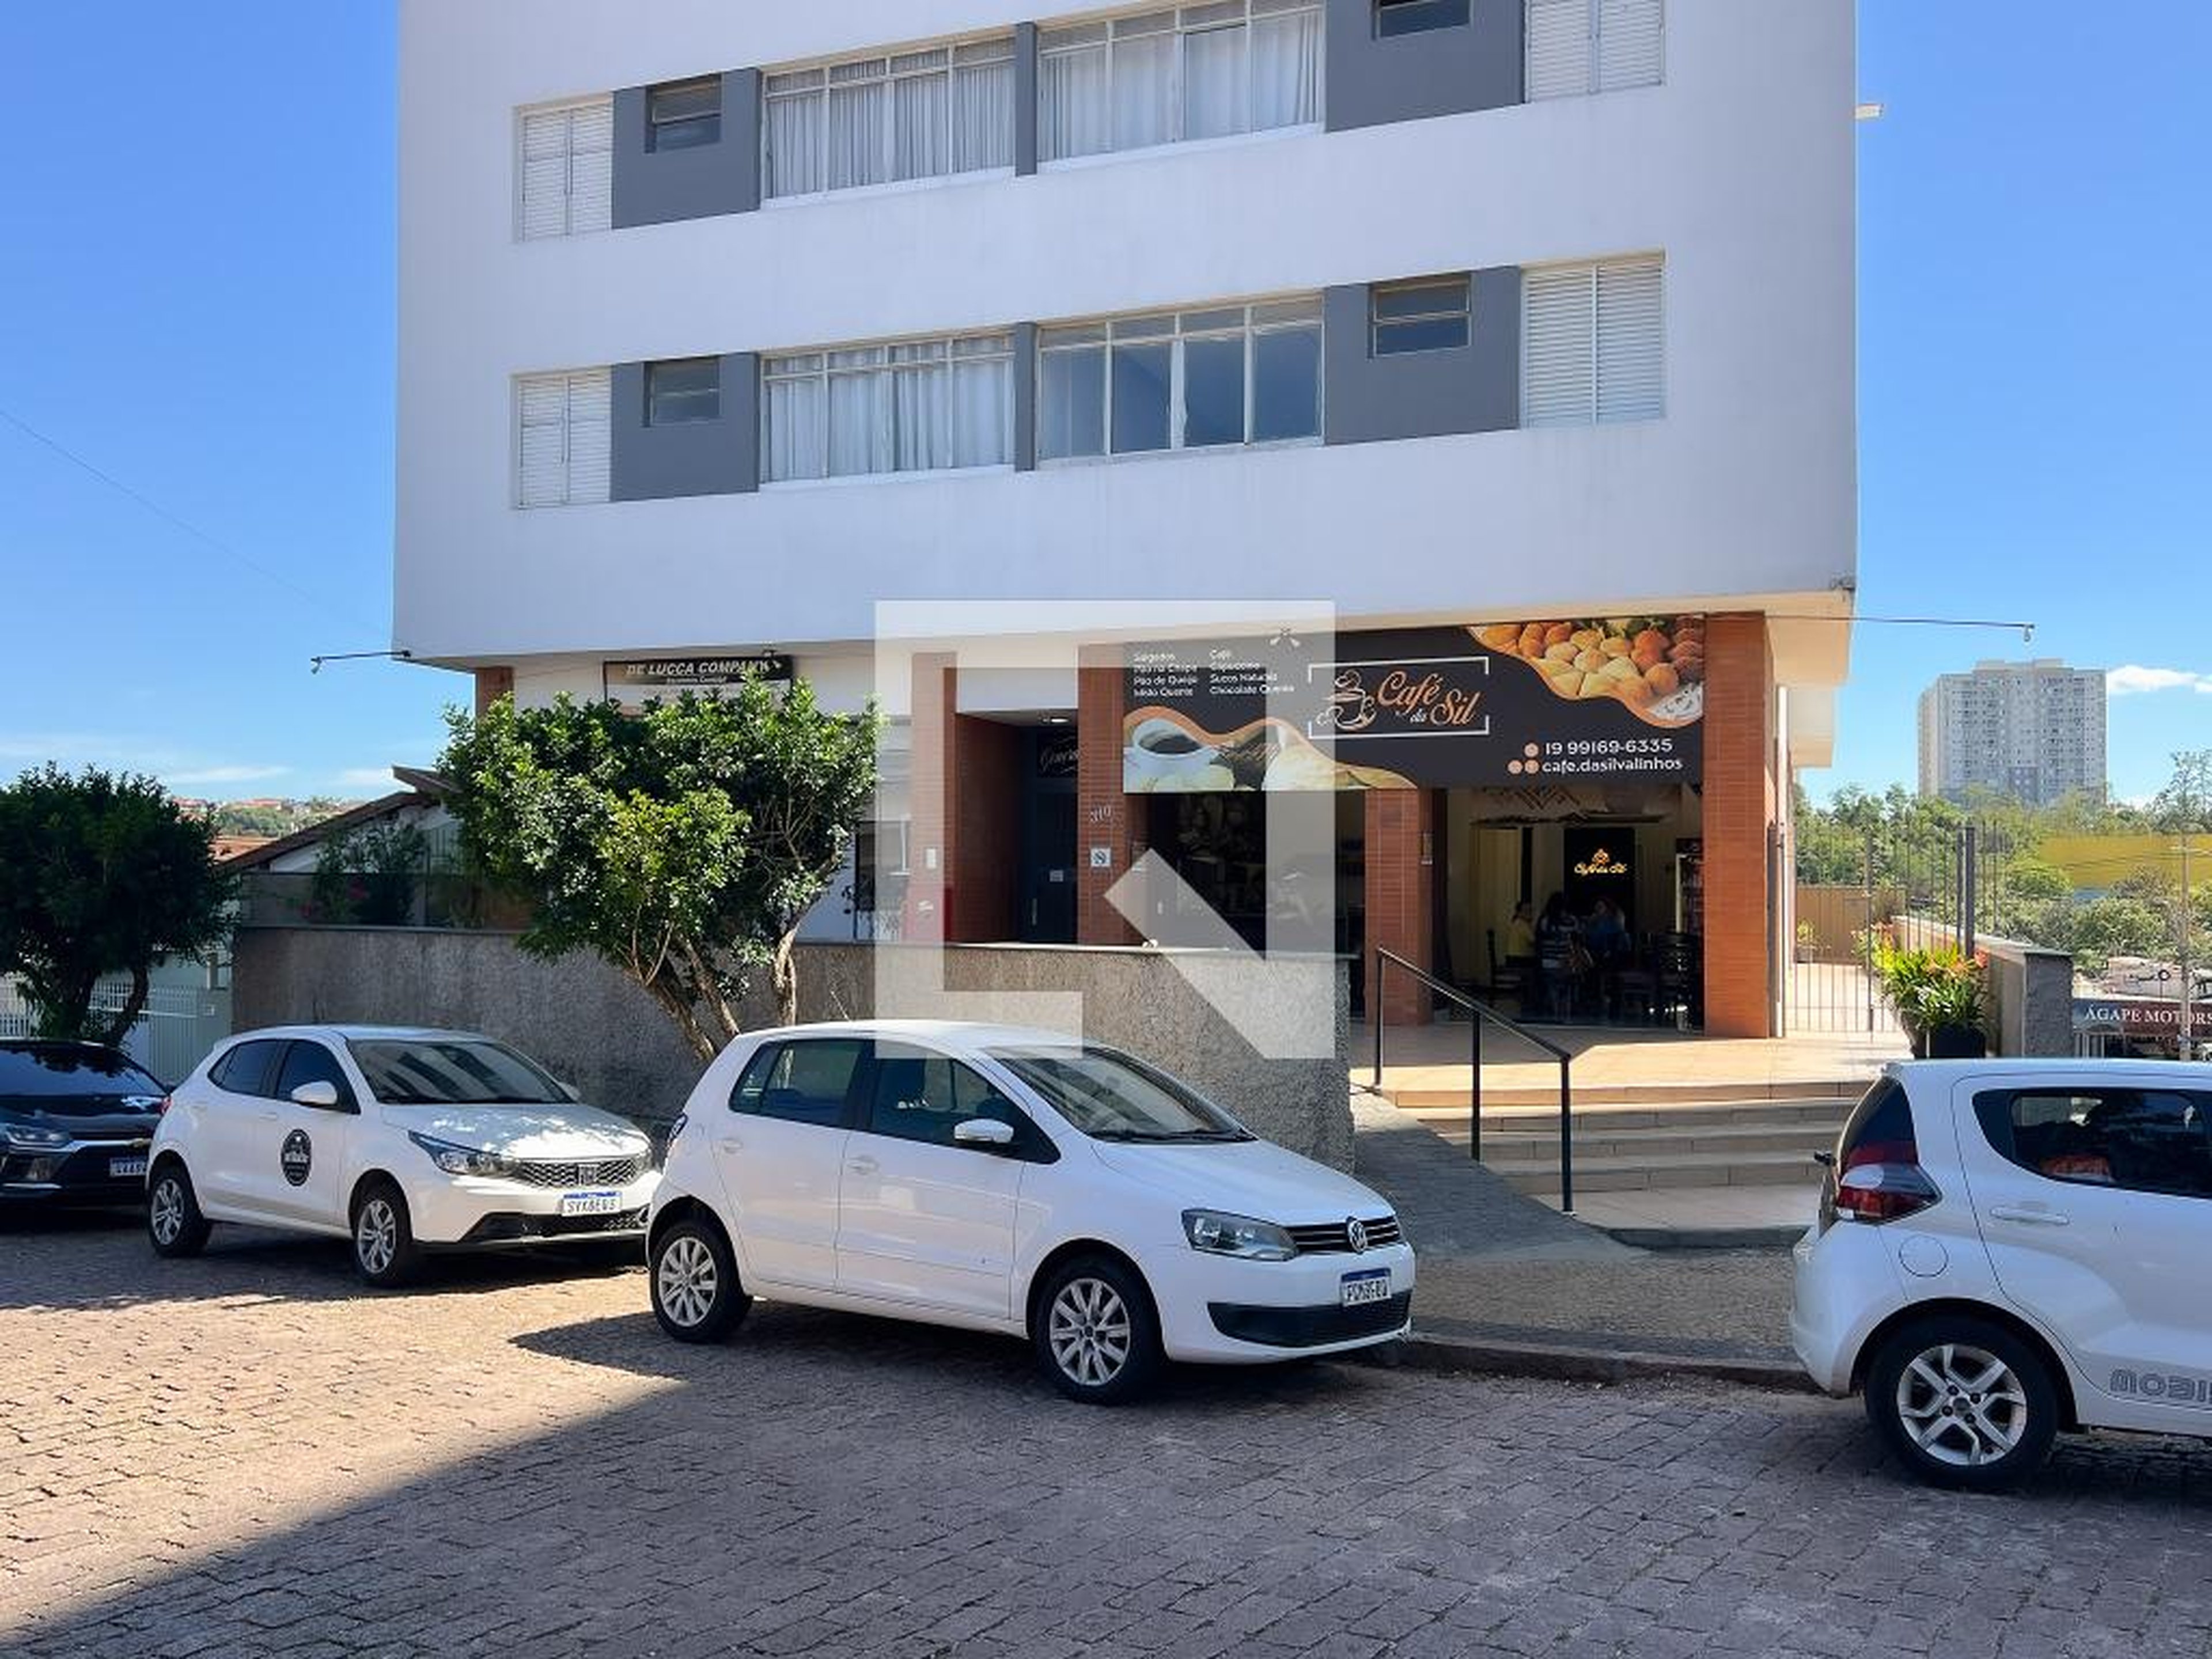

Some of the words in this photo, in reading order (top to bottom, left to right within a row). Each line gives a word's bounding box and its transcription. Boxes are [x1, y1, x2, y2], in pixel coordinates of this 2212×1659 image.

[626, 664, 645, 676] DE
[647, 663, 694, 676] LUCCA
[1153, 676, 1166, 685] de
[1377, 671, 1444, 715] Café
[1430, 688, 1481, 726] Sil
[1546, 742, 1563, 755] 19
[1567, 738, 1673, 755] 99169-6335
[1541, 756, 1684, 774] cafe.dasilvalinhos
[2084, 1003, 2143, 1022] ÁGAPE
[2109, 1369, 2212, 1404] MOBI
